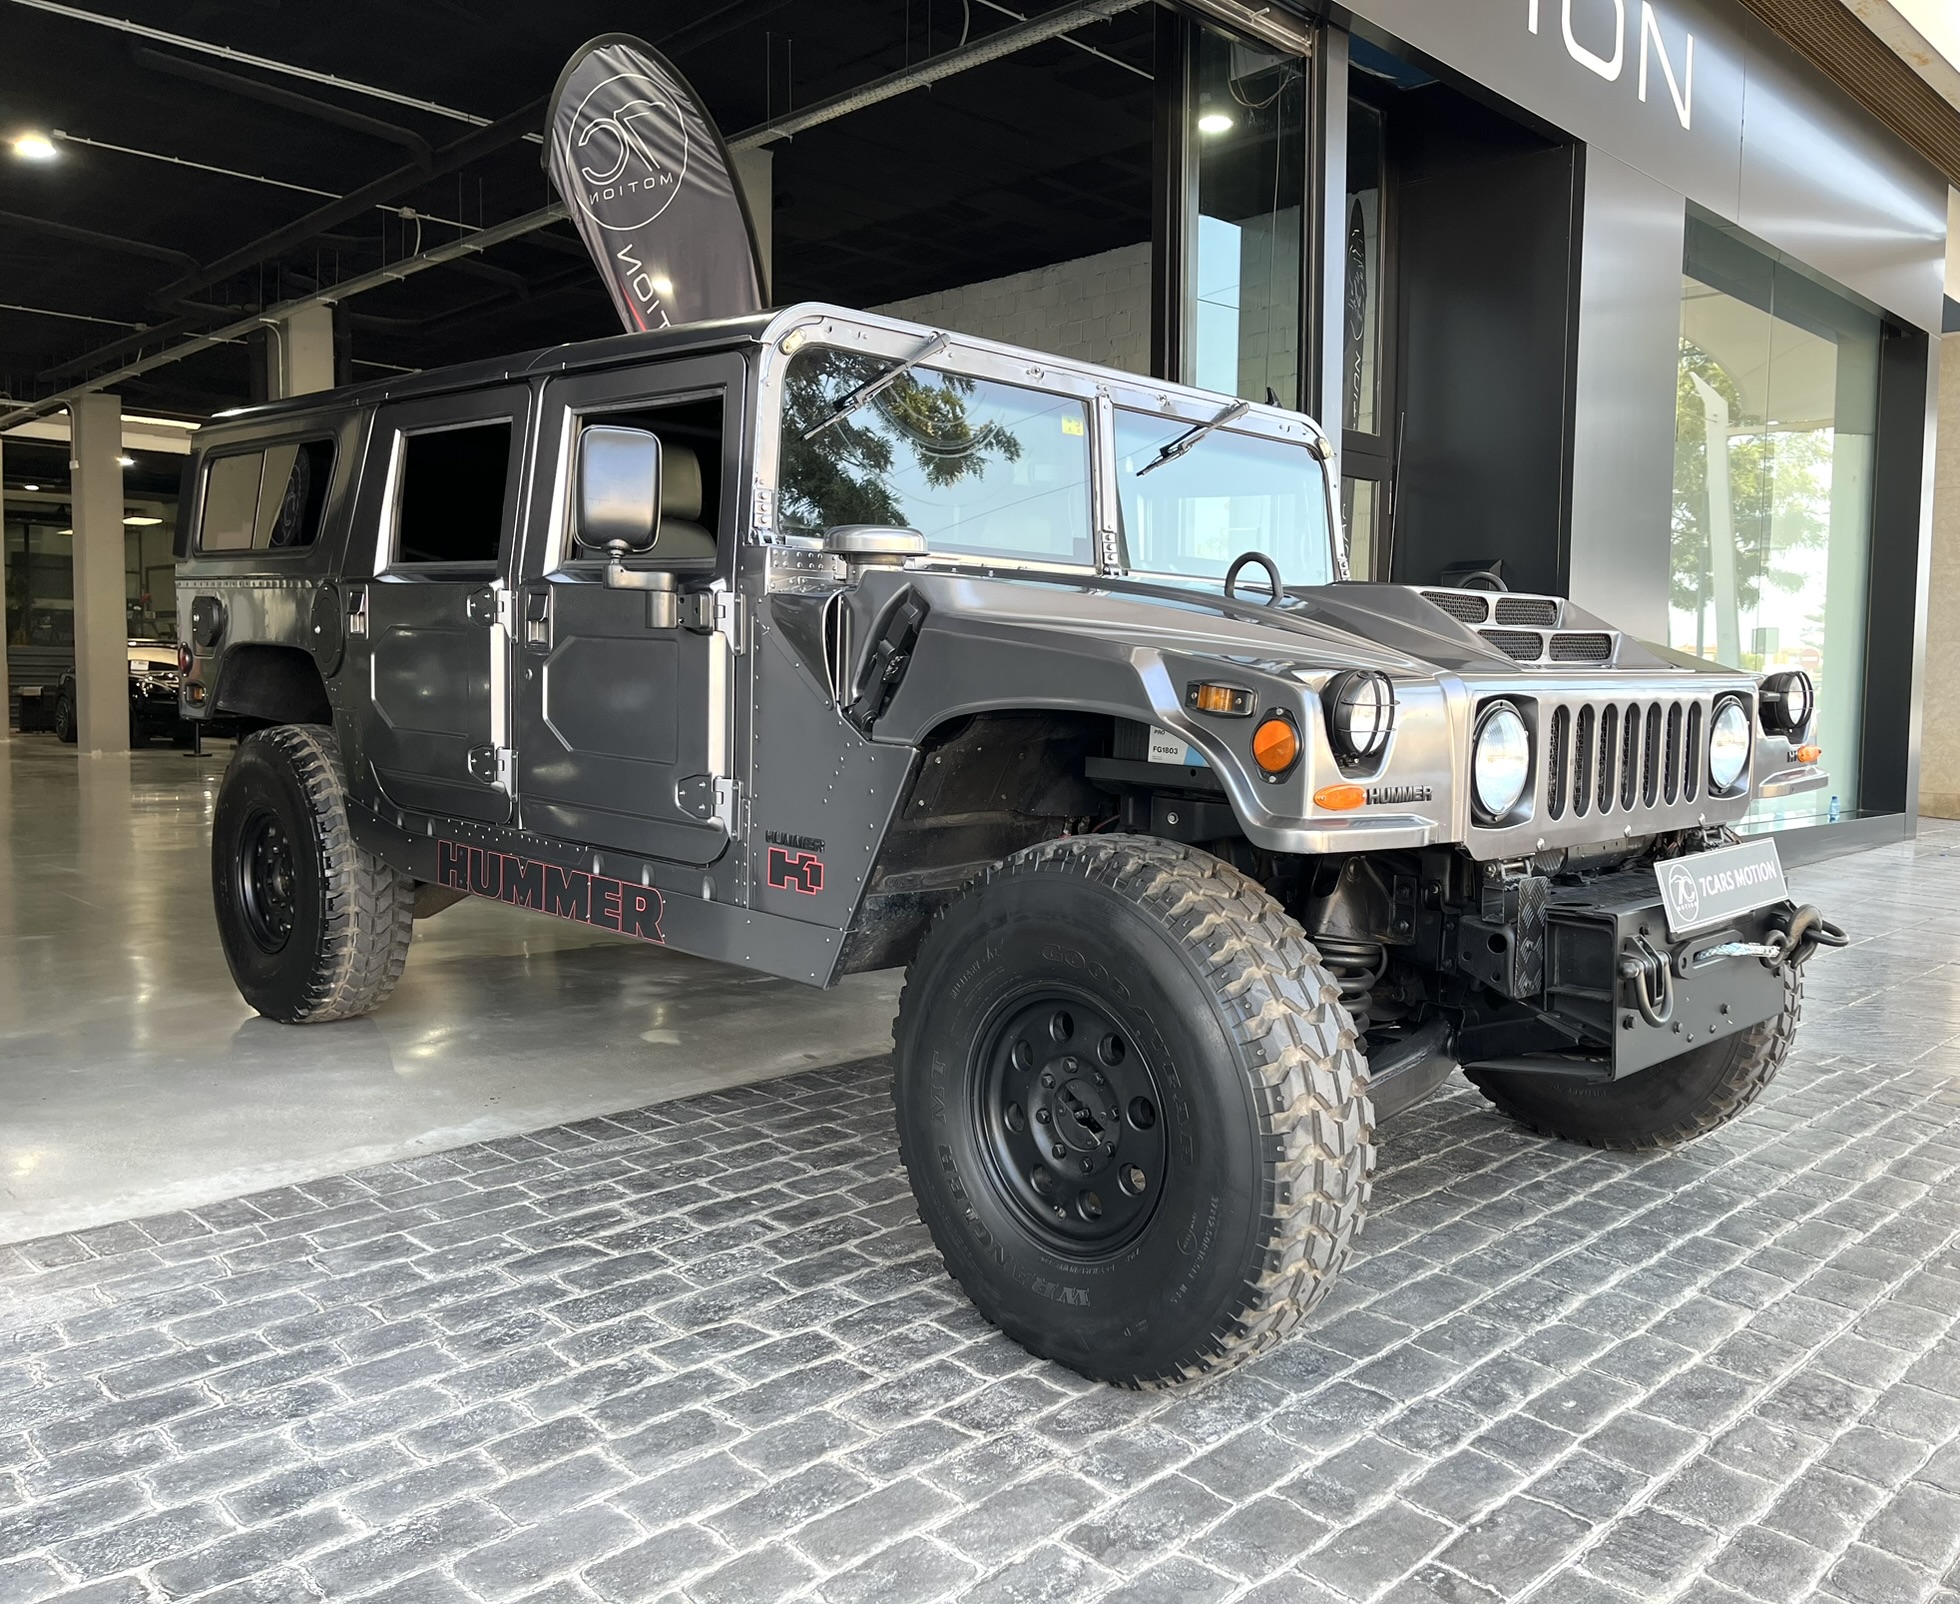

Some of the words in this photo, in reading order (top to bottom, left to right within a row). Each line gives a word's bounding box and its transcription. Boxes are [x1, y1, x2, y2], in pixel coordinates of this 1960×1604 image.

[1366, 785, 1433, 805] HUMMER
[765, 829, 826, 853] HUMMER
[768, 846, 824, 895] H1
[1698, 872, 1735, 897] 7CARS
[1734, 860, 1778, 888] MOTION
[437, 839, 666, 944] HUMMER
